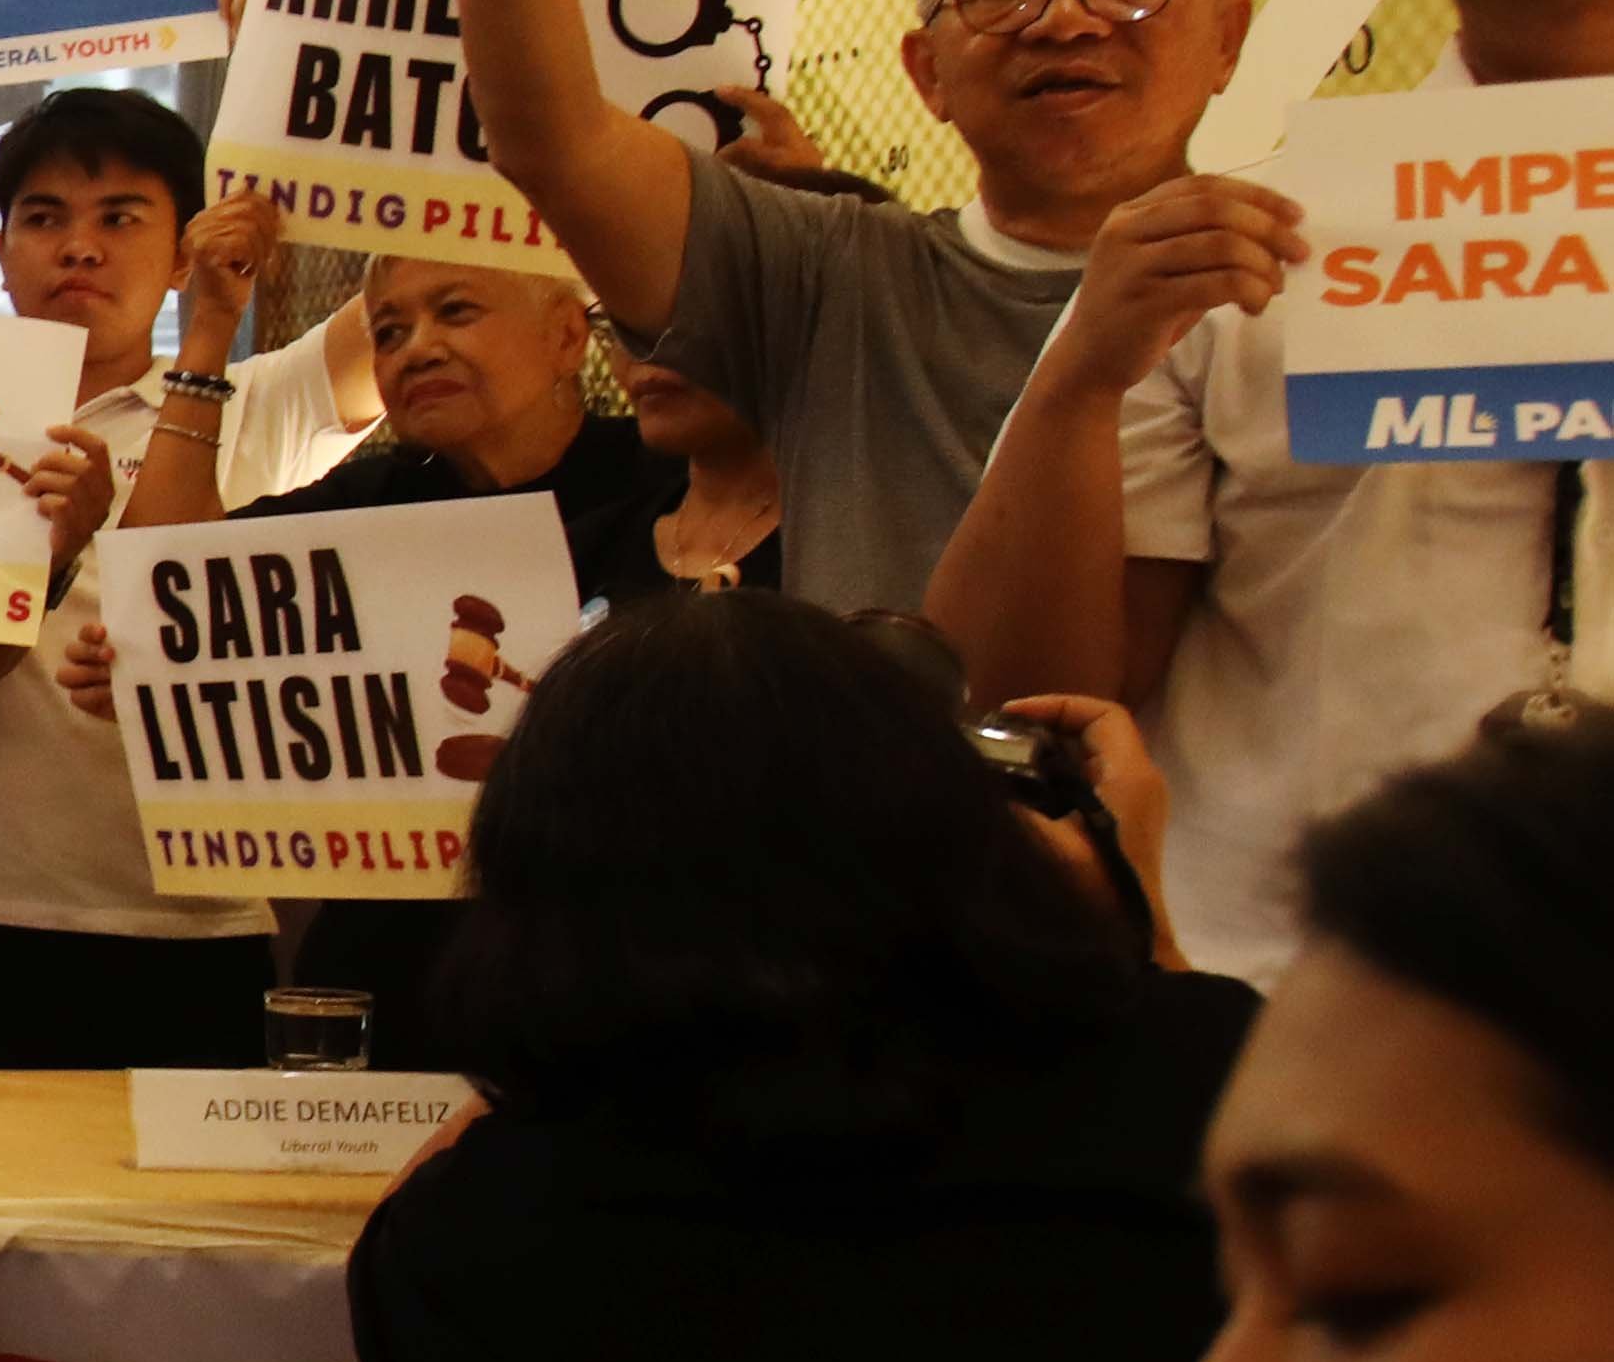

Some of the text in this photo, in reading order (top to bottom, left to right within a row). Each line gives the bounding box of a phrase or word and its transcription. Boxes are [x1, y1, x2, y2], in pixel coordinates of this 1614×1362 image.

[61, 32, 152, 59] YOUTH
[1394, 148, 1614, 221] IMPE
[1321, 234, 1610, 307] SARA
[1366, 394, 1497, 449] ML
[151, 548, 362, 664] SARA
[137, 672, 424, 783] LITISIN
[156, 830, 462, 871] TINDIG PILIP
[204, 1099, 450, 1125] ADDIE DEMAFELIZ
[280, 1140, 379, 1154] Liberal Youth
